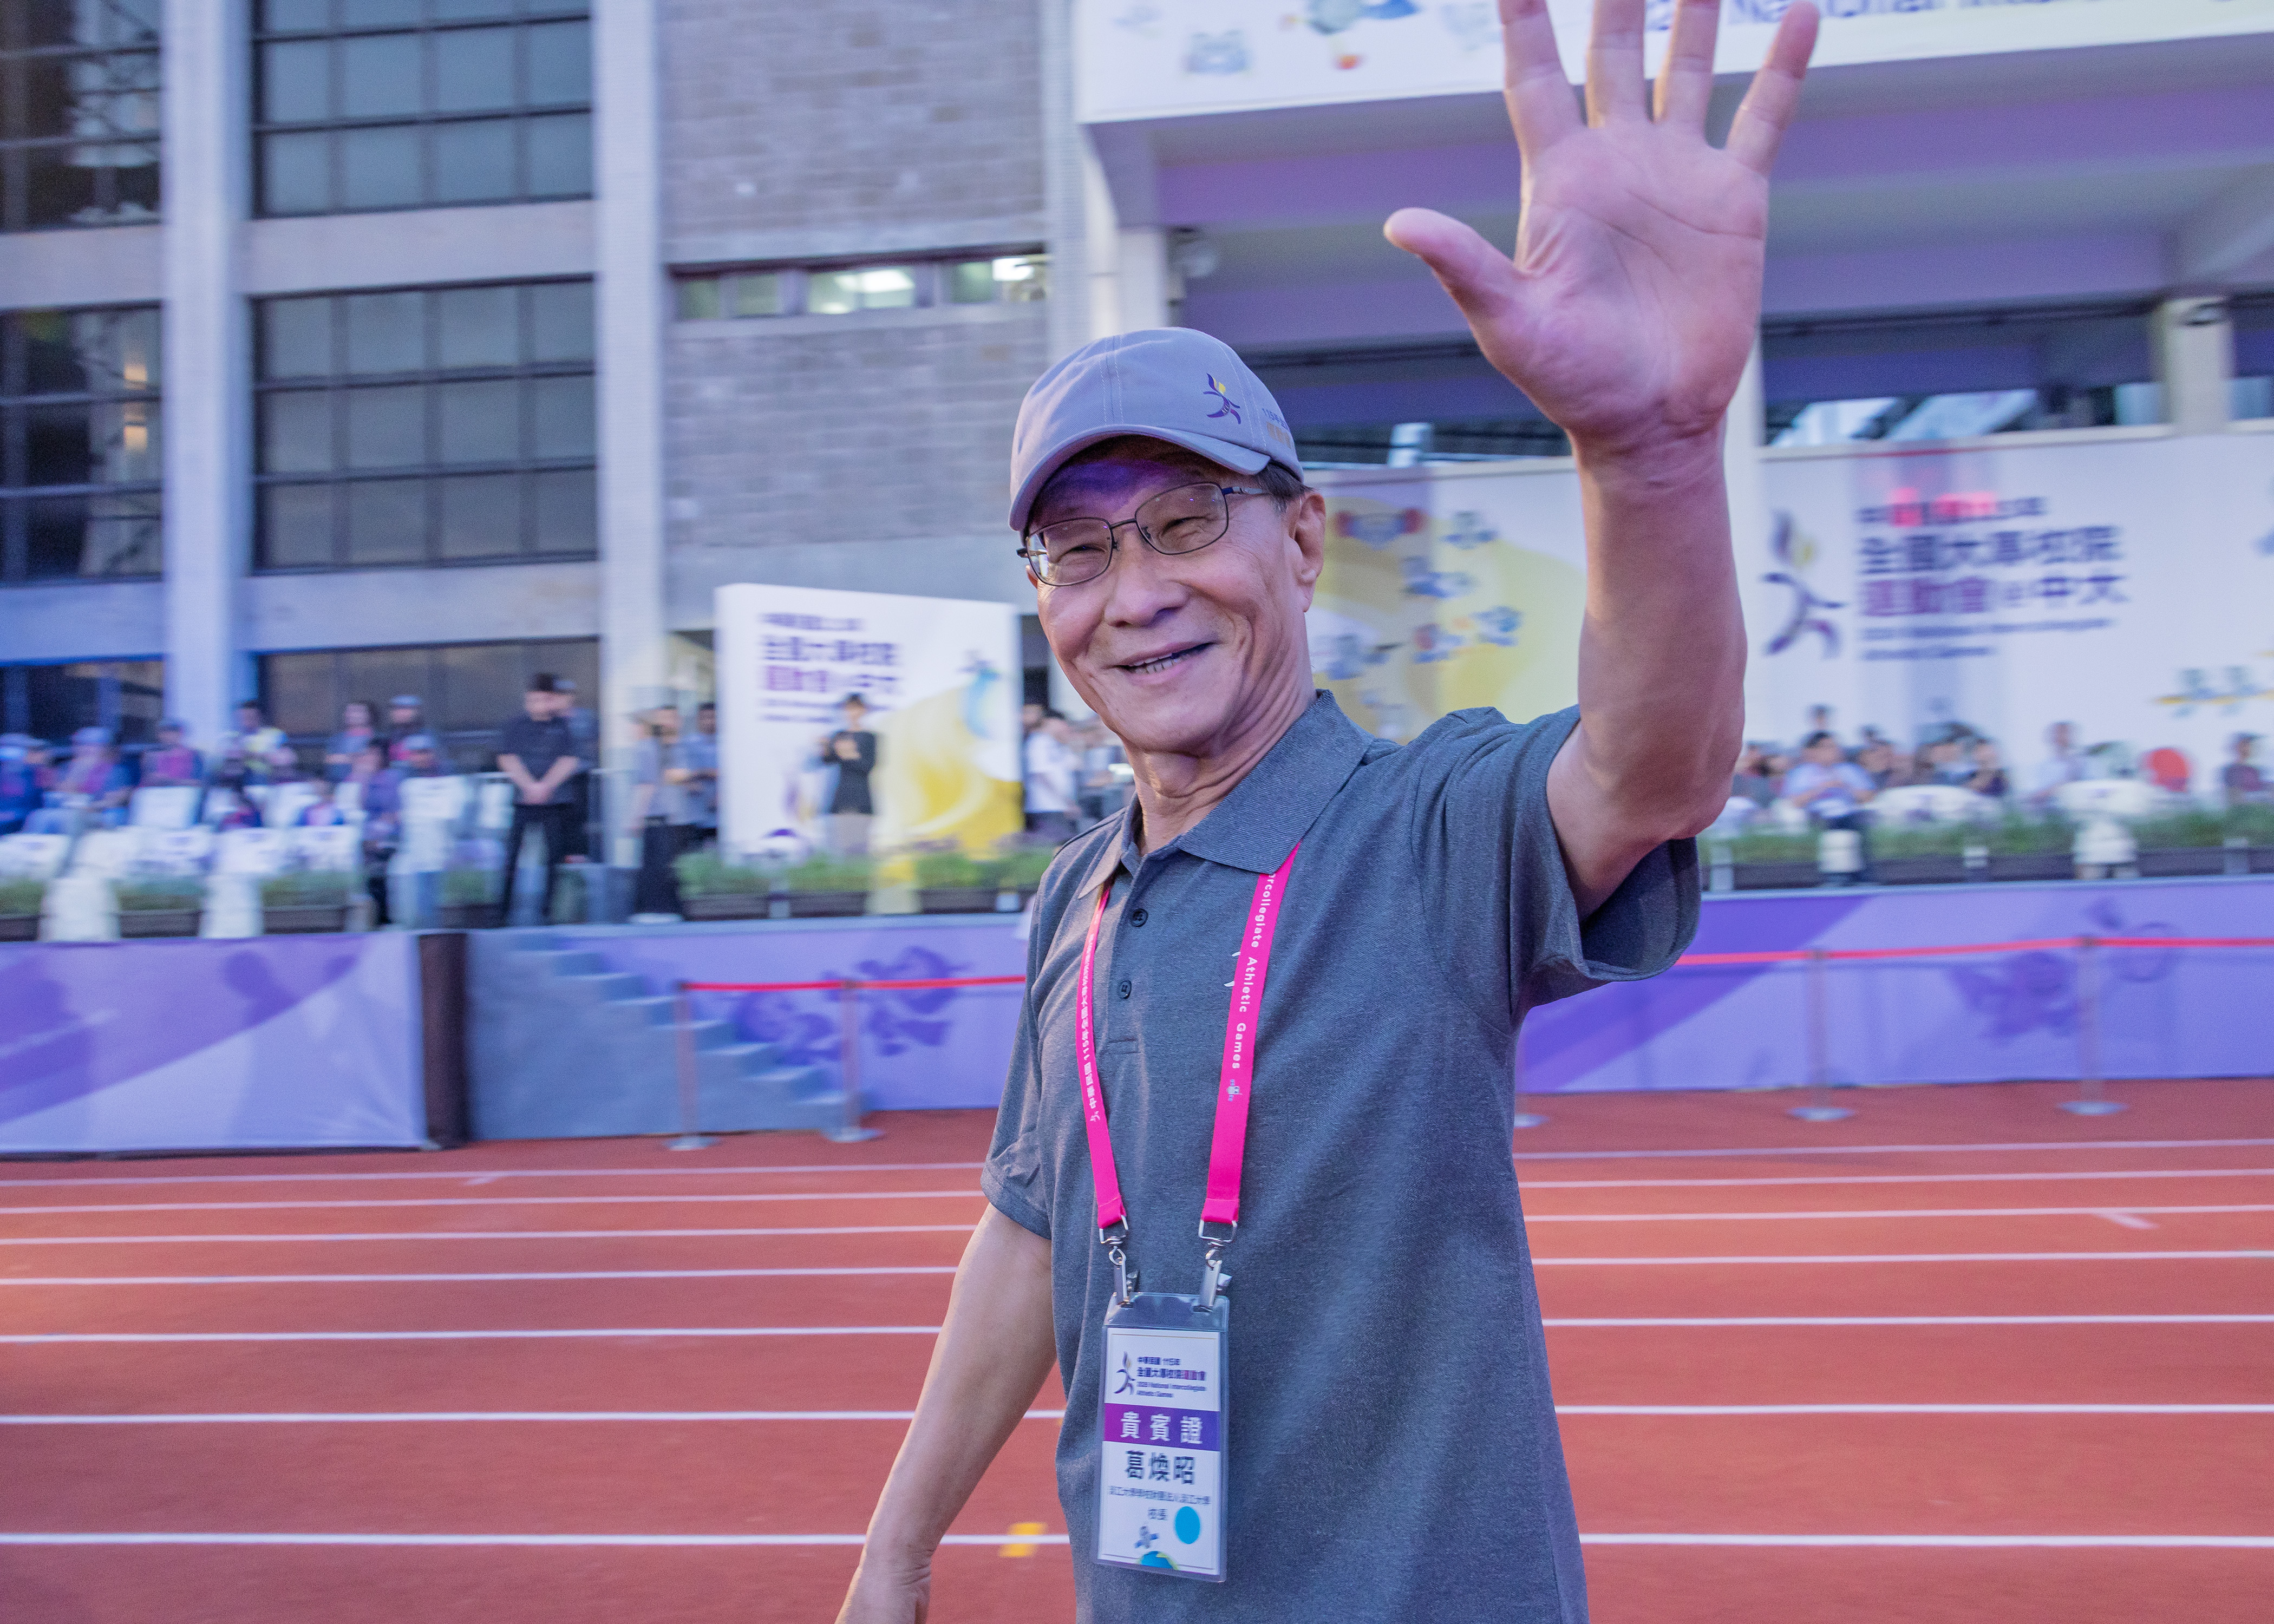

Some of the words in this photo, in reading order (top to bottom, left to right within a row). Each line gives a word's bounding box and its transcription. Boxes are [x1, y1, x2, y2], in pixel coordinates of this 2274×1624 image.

[1239, 957, 1258, 1013] Athletic
[1232, 1022, 1246, 1069] Games
[1120, 1411, 1203, 1444] 貴賓證
